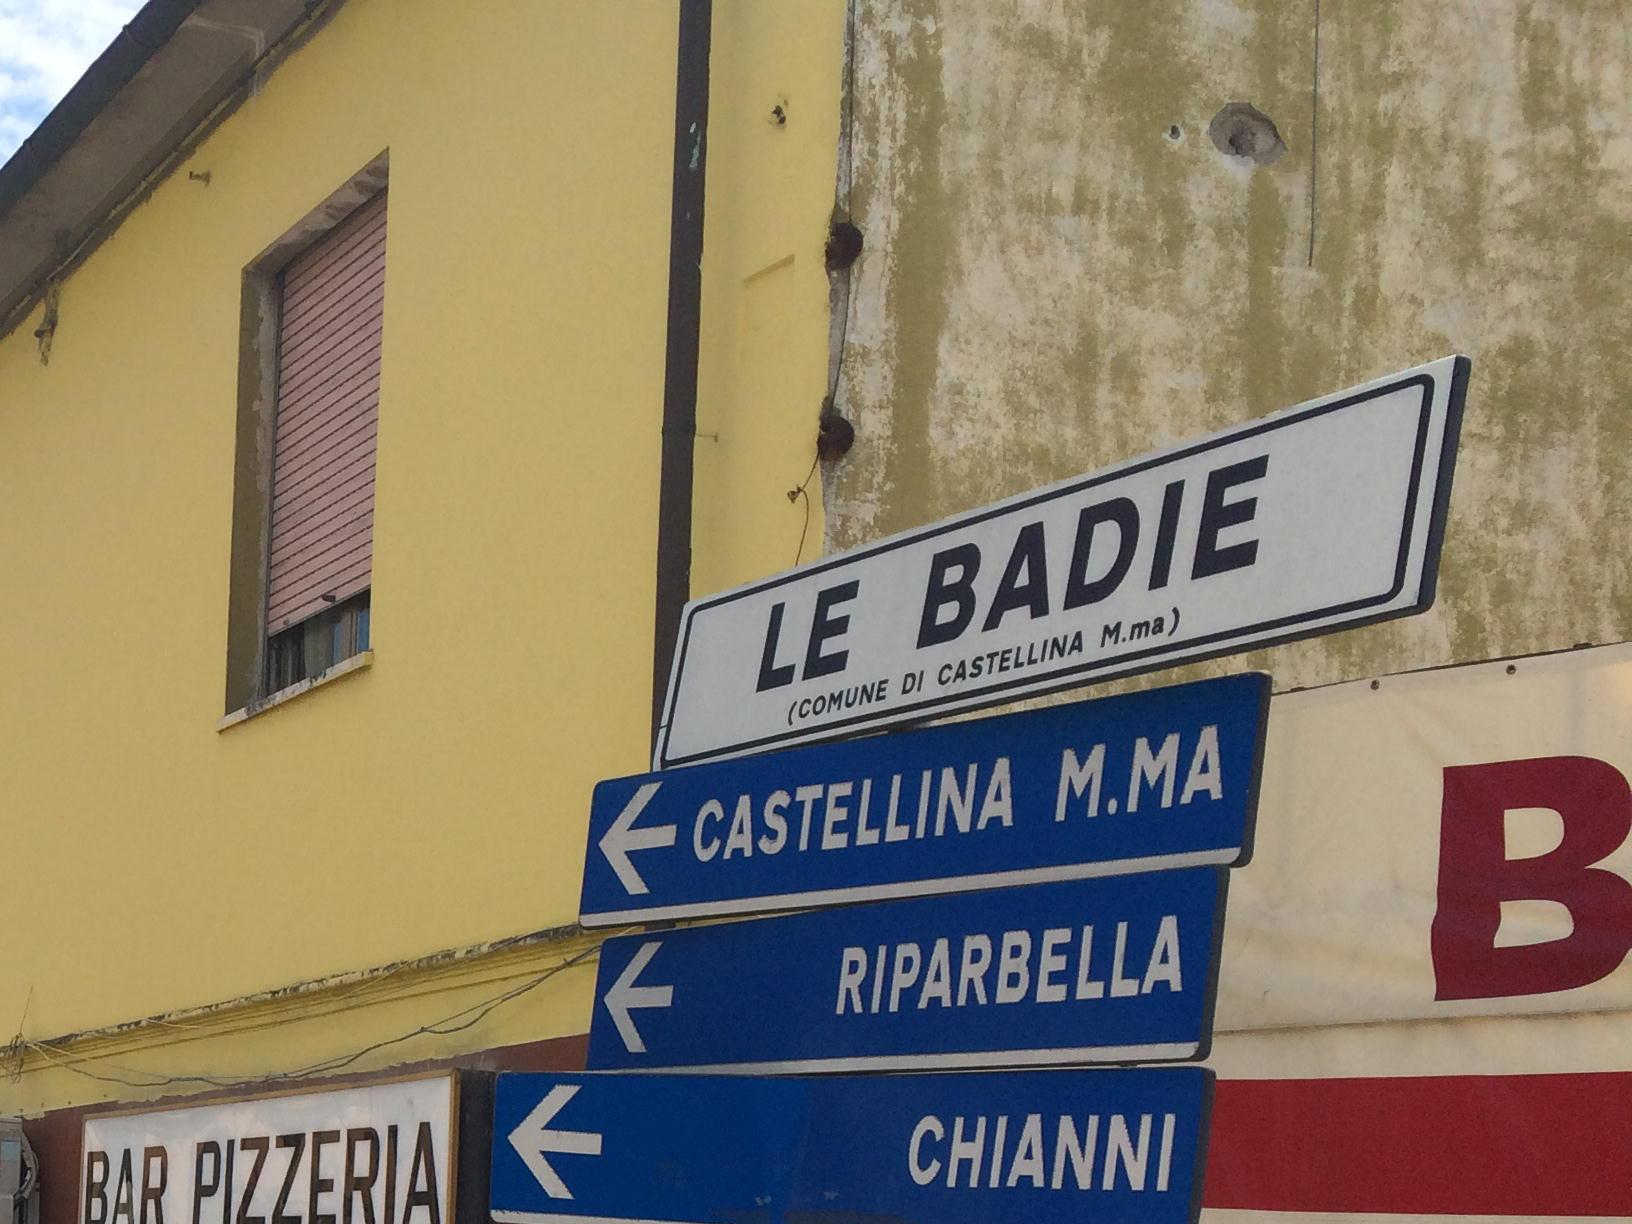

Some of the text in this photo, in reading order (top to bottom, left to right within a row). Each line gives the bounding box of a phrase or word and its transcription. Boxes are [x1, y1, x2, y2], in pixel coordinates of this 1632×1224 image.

[756, 454, 1269, 693] LE BADIE
[788, 606, 1180, 726] (COMUNE DI CASTELLINA M.ma)
[692, 724, 1223, 863] CASTELLINA M.MA
[835, 914, 1183, 1015] RIPARBELLA
[908, 1113, 1176, 1191] CHIANNI
